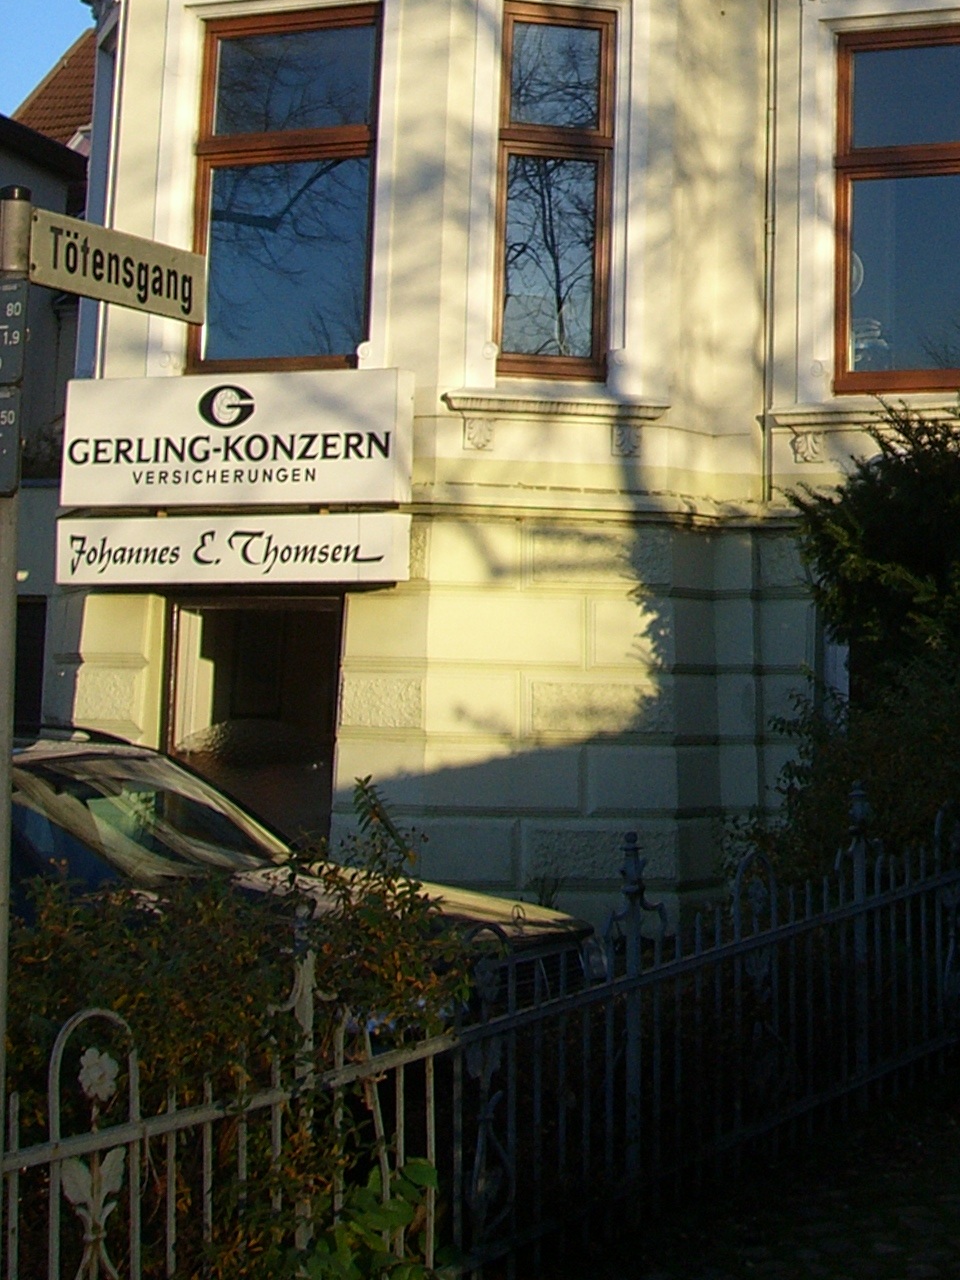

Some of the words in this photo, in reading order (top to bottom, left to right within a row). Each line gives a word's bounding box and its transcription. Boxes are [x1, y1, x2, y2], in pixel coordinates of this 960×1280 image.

[50, 226, 193, 314] Tötensgang
[6, 301, 21, 317] 80
[68, 432, 391, 465] GERLING-KONZERN
[132, 468, 317, 485] VERSICHERUNGEN
[69, 534, 180, 576] Johannes
[193, 531, 221, 565] E.
[228, 531, 384, 575] Thomsen
